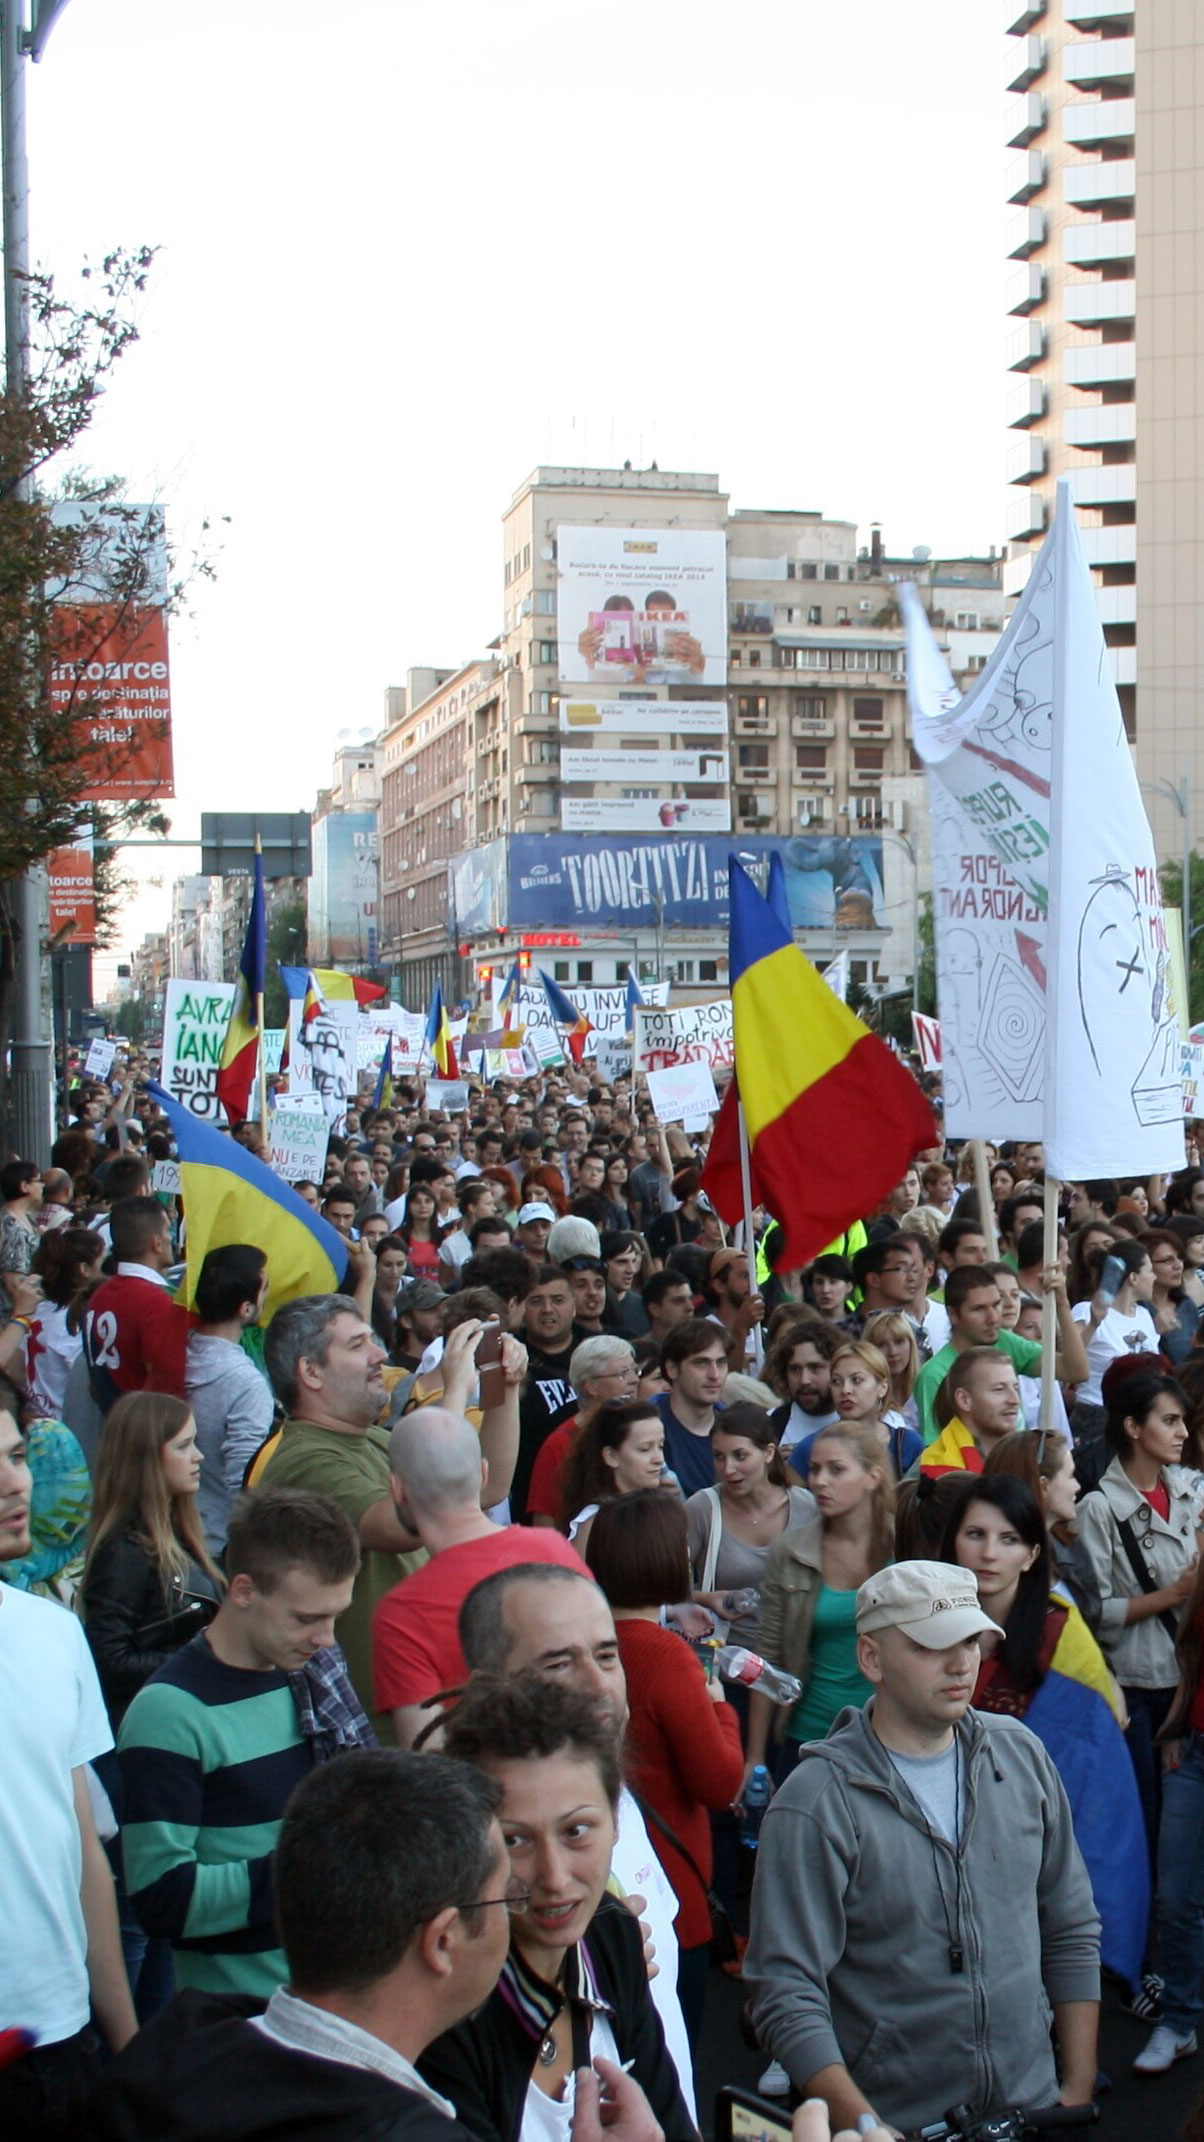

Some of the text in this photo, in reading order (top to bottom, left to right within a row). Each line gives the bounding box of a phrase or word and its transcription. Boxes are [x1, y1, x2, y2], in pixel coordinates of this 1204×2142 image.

[639, 611, 686, 622] IKEA
[522, 931, 582, 947] HOTEL
[283, 1129, 317, 1147] MEA
[270, 1147, 317, 1166] NU E DE
[86, 1310, 121, 1370] 12
